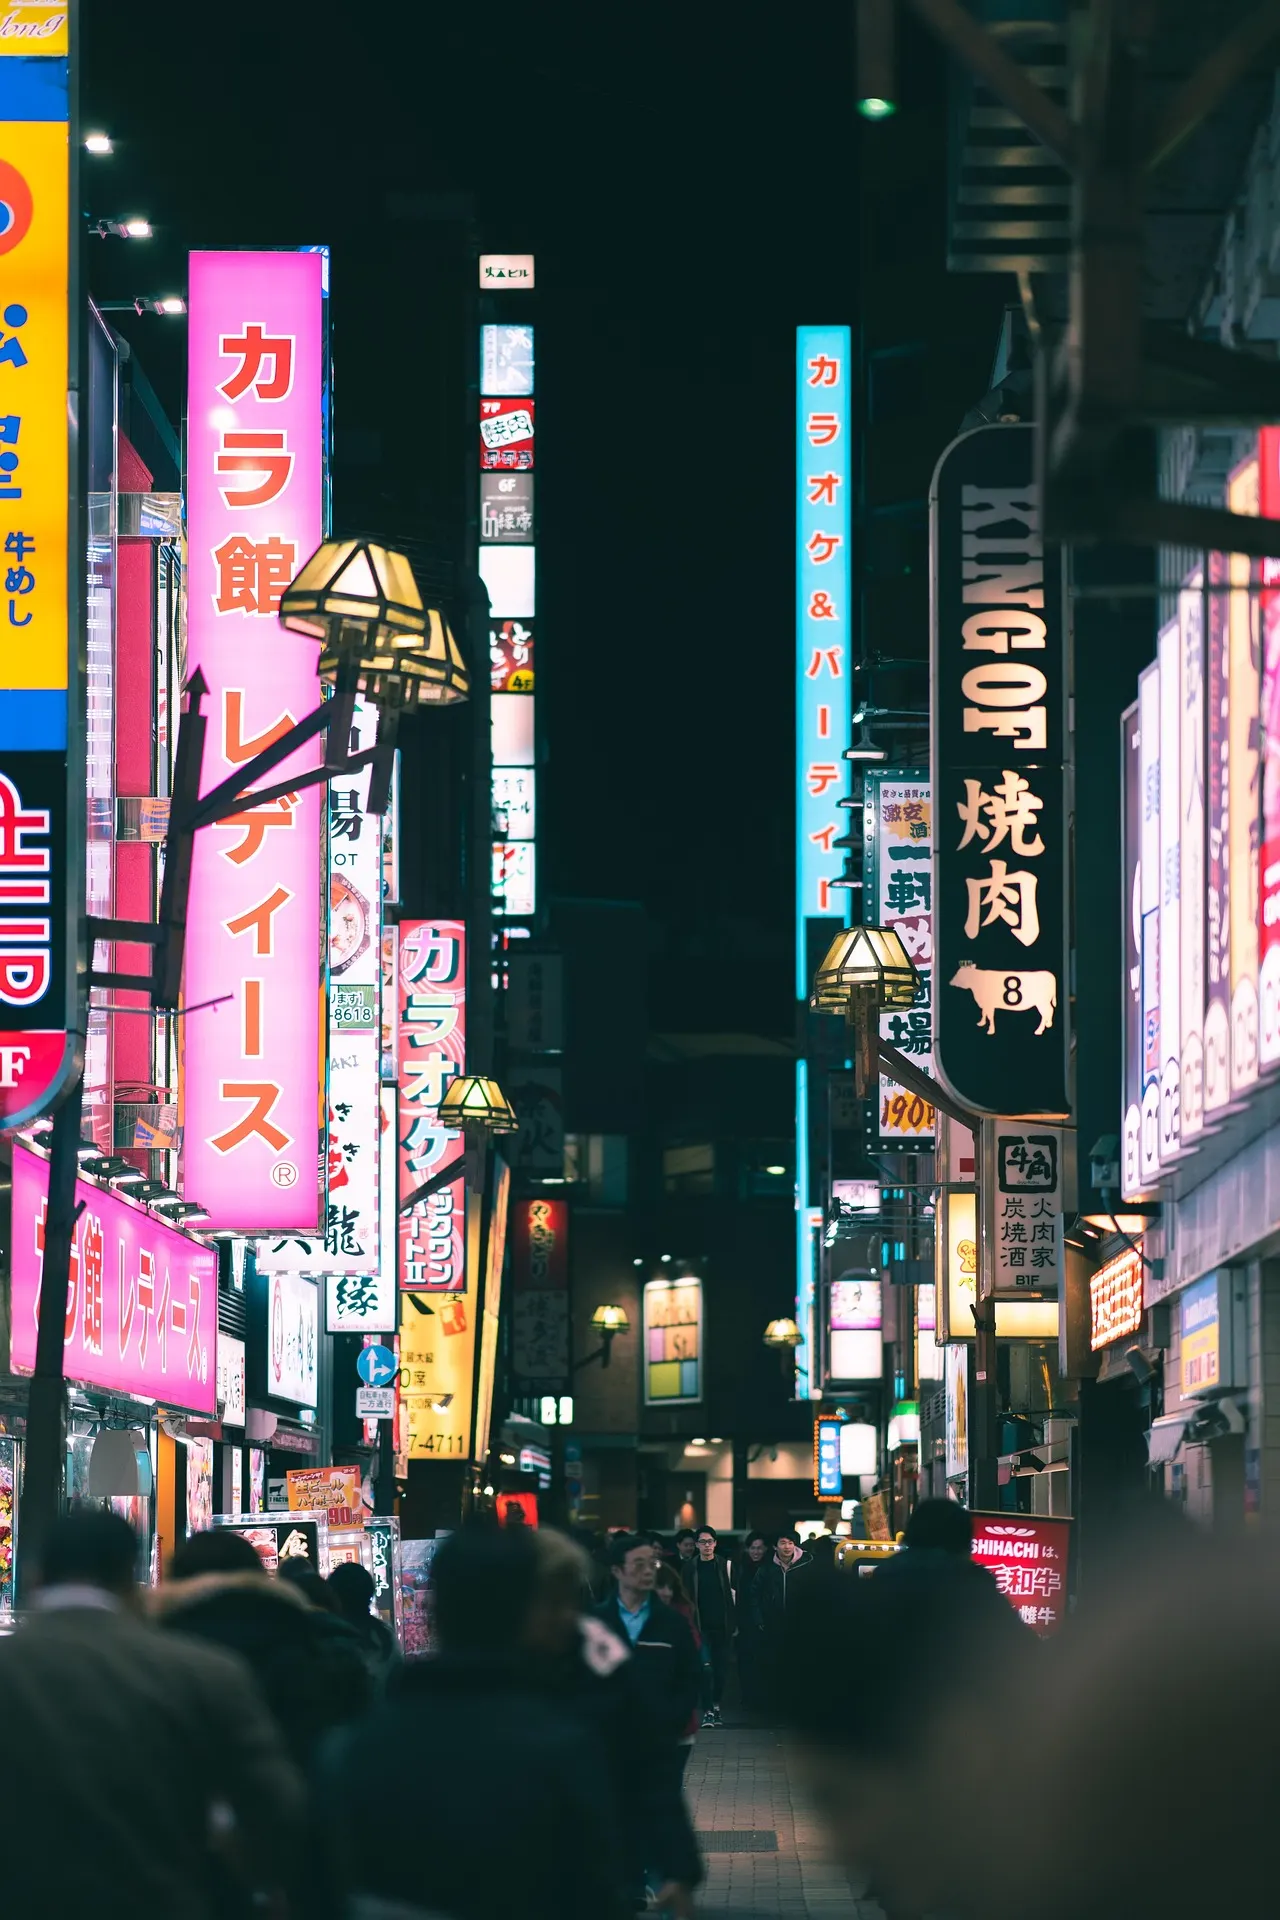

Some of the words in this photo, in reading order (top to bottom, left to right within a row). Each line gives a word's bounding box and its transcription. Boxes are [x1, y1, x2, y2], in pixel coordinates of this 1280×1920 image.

[498, 478, 516, 492] 6F
[5, 531, 36, 627] 牛めし
[956, 769, 1046, 947] 焼肉
[1003, 976, 1023, 1006] 8
[400, 927, 461, 1171] カラオケ
[1006, 1146, 1051, 1181] 牛角
[1015, 1275, 1039, 1285] B1F
[118, 1238, 203, 1381] レディース
[360, 1400, 392, 1408] 一方通行
